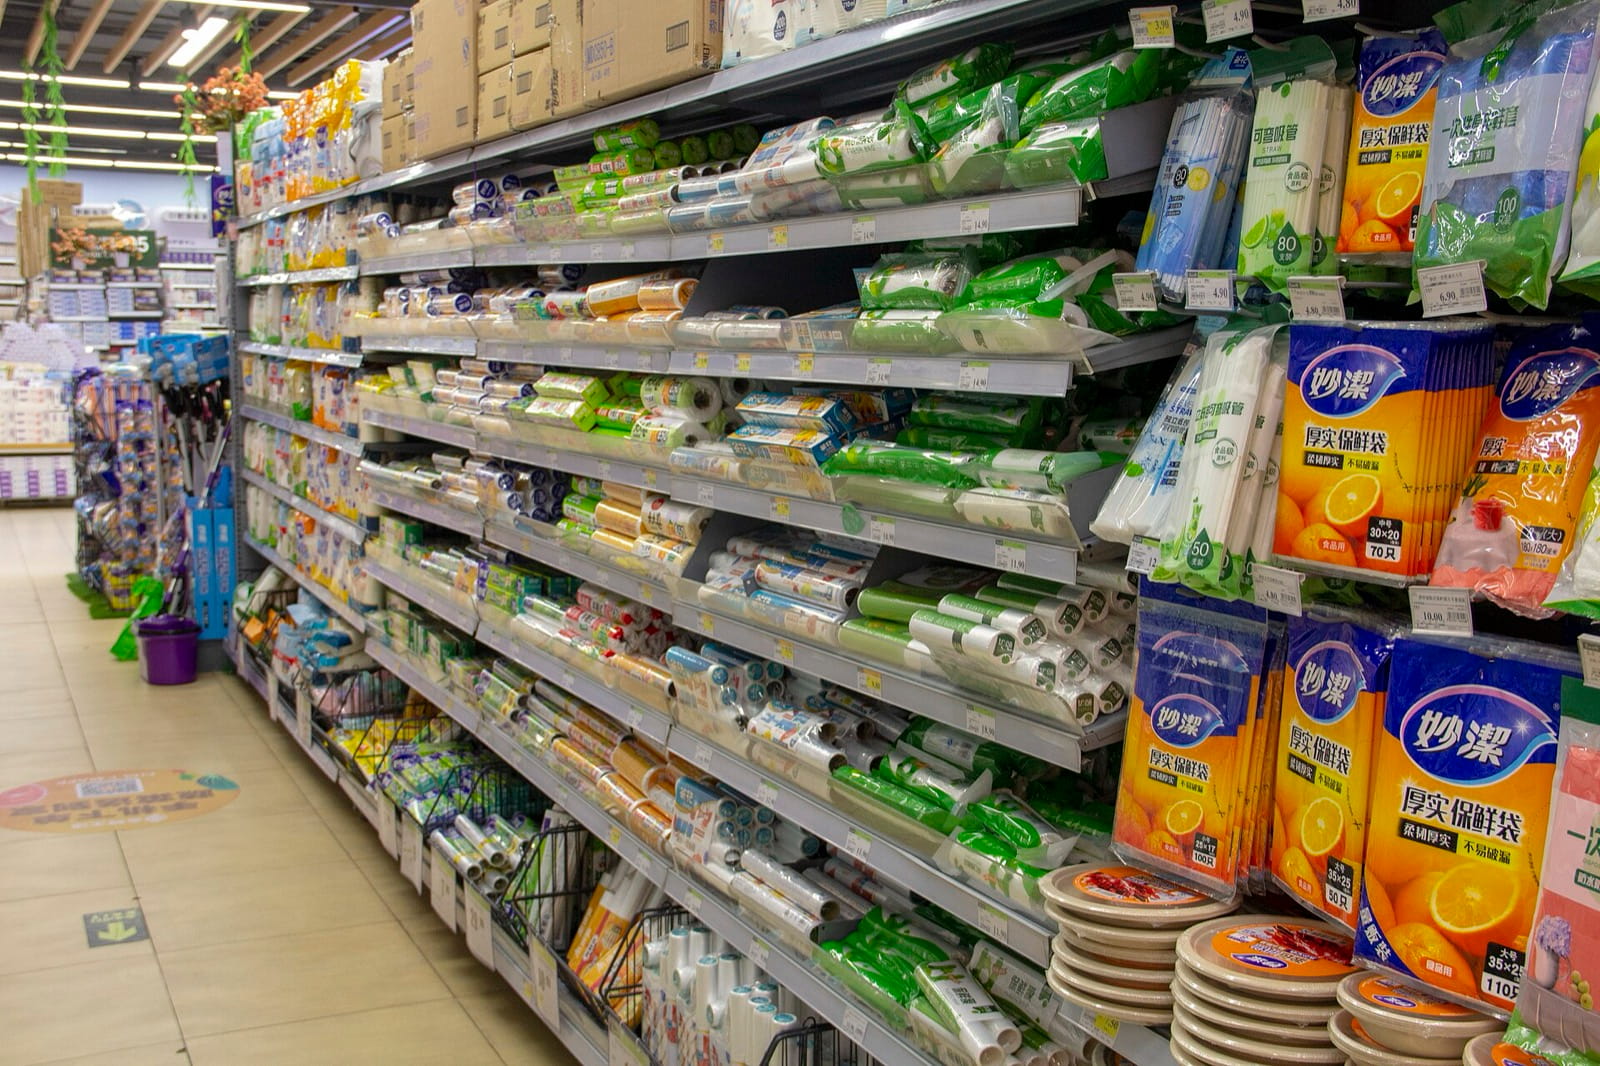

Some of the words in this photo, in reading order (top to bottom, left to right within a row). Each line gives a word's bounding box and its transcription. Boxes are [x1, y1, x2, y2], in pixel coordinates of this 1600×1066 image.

[1253, 124, 1298, 144] 可弯吸管
[1359, 122, 1429, 148] 厚实保鲜袋
[1175, 168, 1187, 180] 80
[1498, 197, 1517, 213] 100
[1277, 236, 1297, 251] 80
[1213, 287, 1228, 298] 4.90
[1439, 291, 1456, 302] 6.90
[1308, 367, 1375, 400] 妙潔
[1305, 426, 1387, 454] 厚实保鲜袋
[1191, 541, 1209, 557] 50
[1370, 546, 1396, 560] 70只
[1300, 661, 1352, 708] 妙潔
[1157, 706, 1202, 737] 妙潔
[1413, 709, 1513, 767] 妙潔
[1290, 725, 1351, 776] 厚实保鲜袋
[1150, 748, 1209, 781] 厚实保鲜袋
[1402, 786, 1522, 843] 厚实保鲜袋
[1403, 823, 1451, 848] 柔韧厚实
[1463, 839, 1511, 865] 不易破漏
[1195, 852, 1214, 867] 100只
[1328, 868, 1351, 889] 35×25
[1329, 889, 1348, 911] 50只
[1500, 948, 1517, 961] 大号
